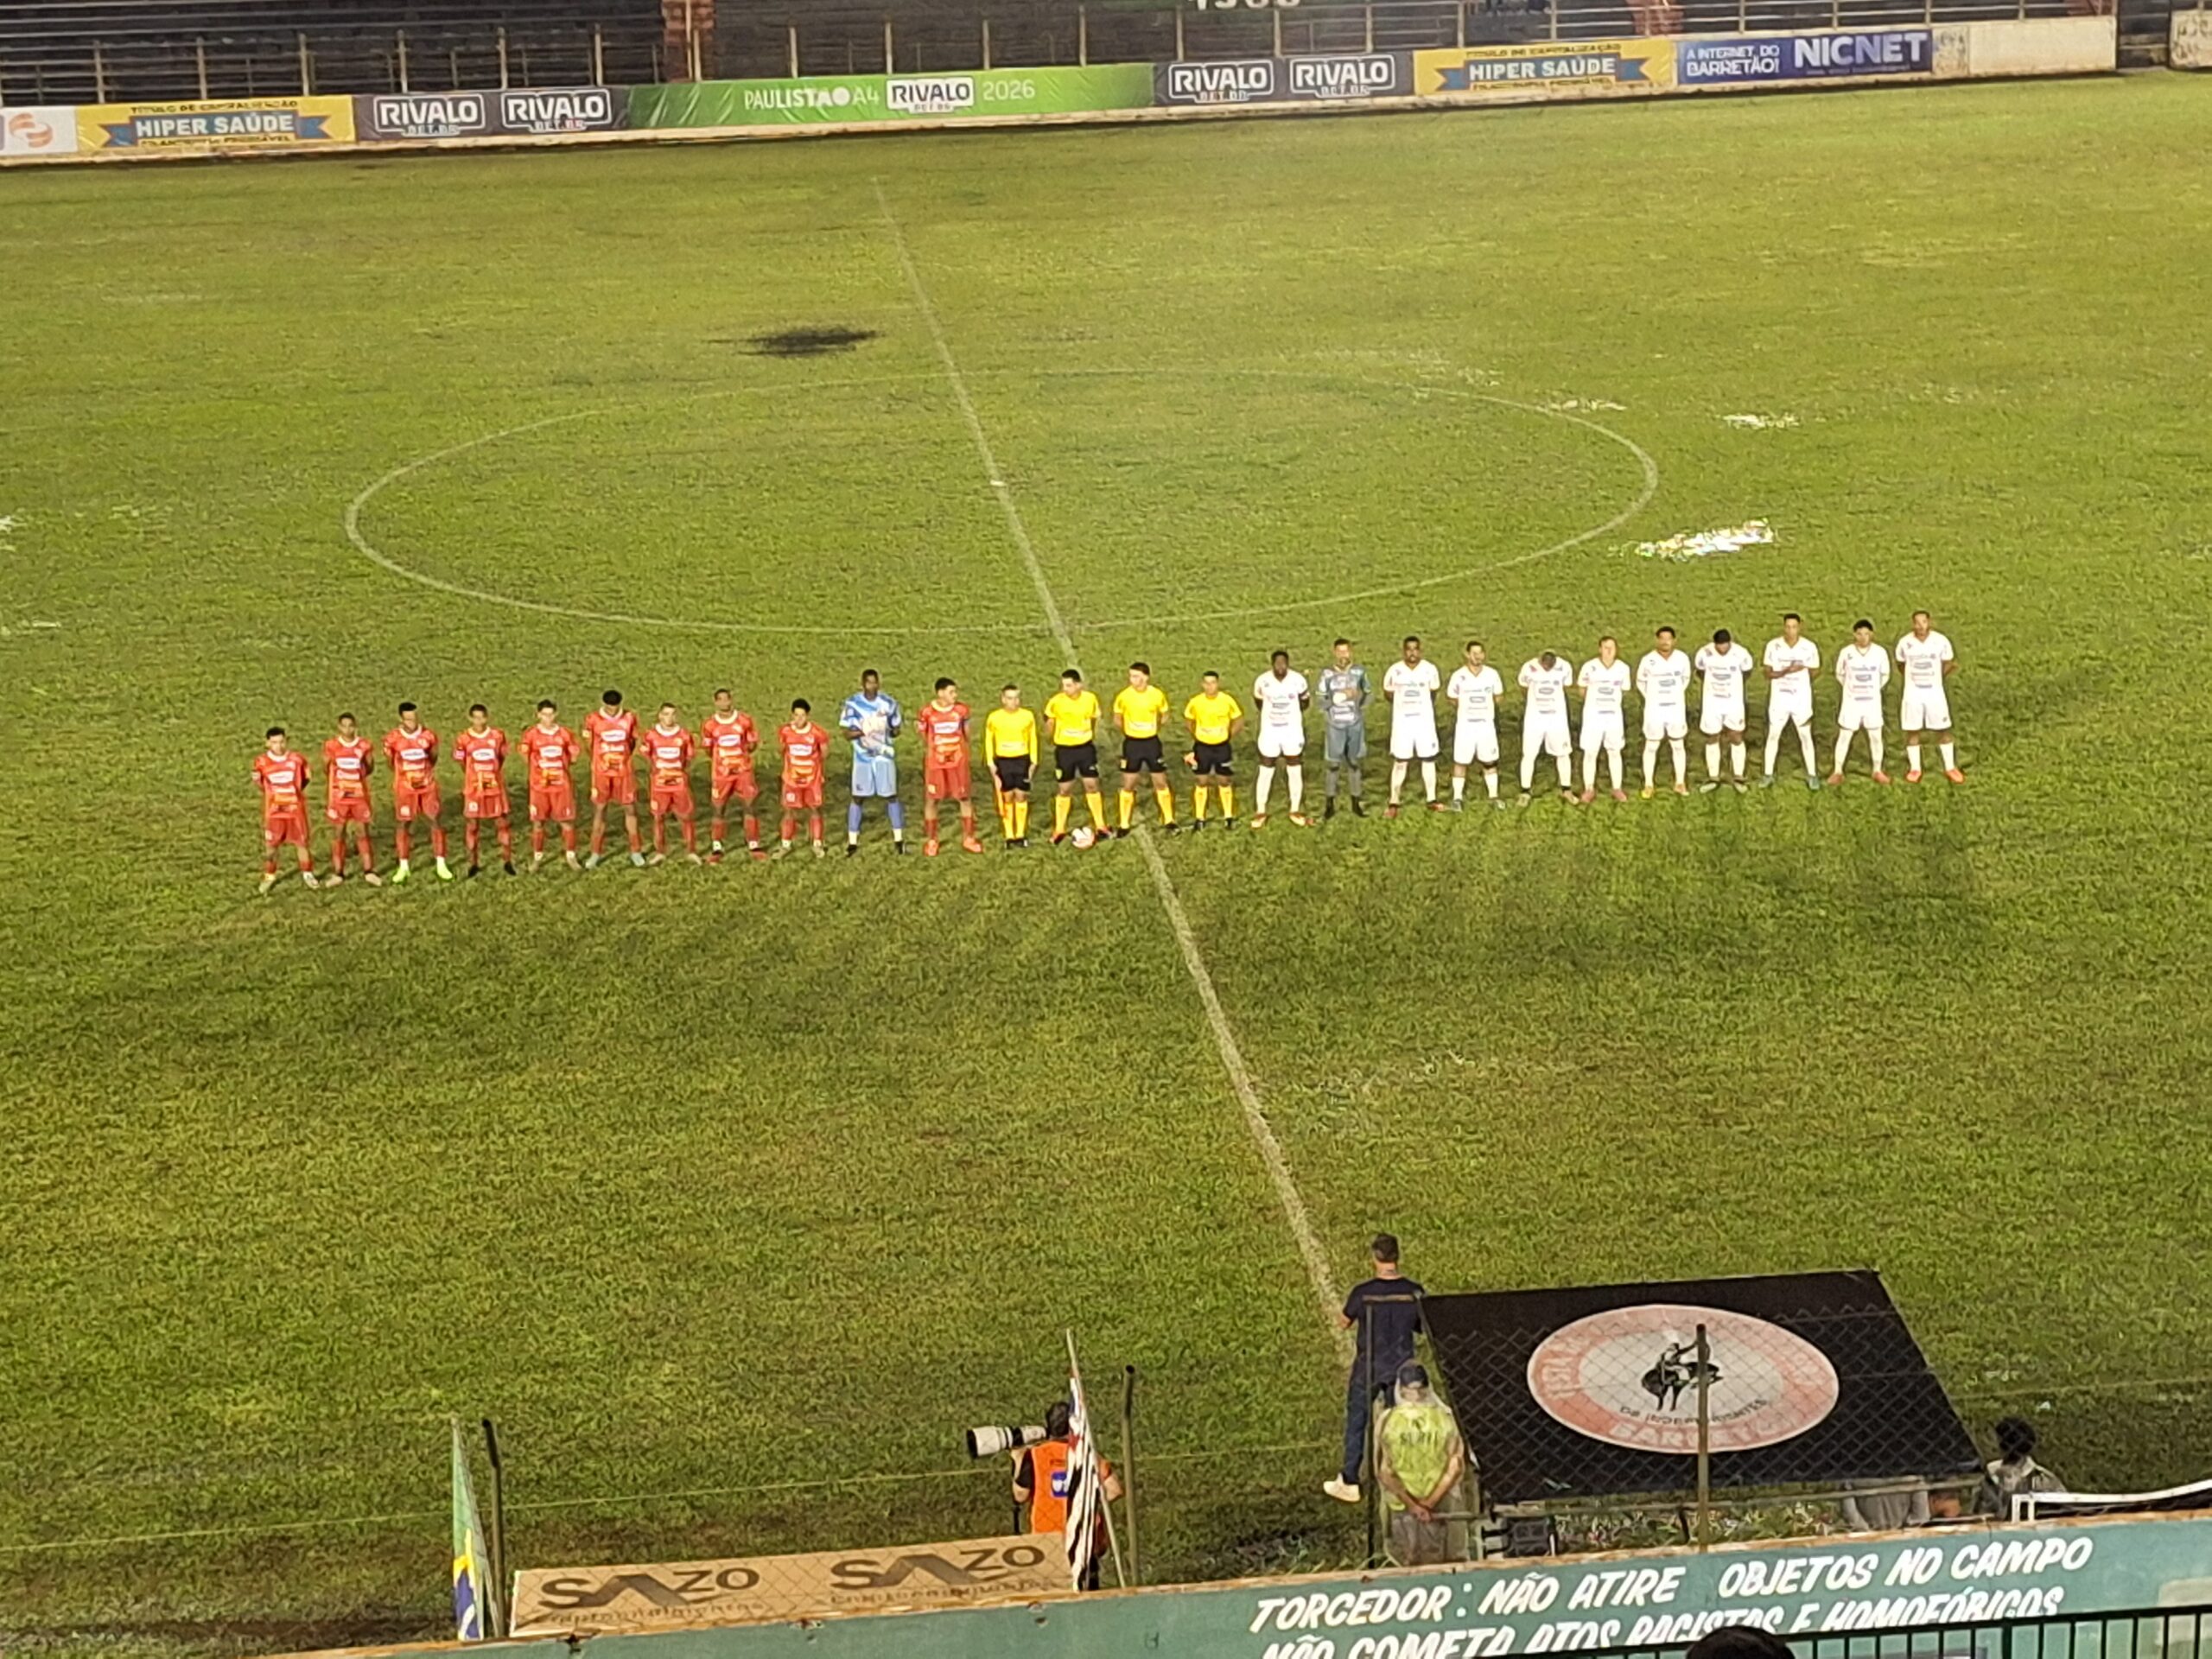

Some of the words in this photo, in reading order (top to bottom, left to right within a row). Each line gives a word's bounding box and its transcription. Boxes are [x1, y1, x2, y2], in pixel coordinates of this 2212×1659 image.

[1760, 45, 1780, 57] DO
[1795, 32, 1928, 68] NICNET
[1175, 67, 1268, 92] RIVALO
[1296, 61, 1389, 87] RIVALO
[1470, 61, 1536, 81] HIPER
[1541, 56, 1616, 77] SAÚDE
[892, 83, 970, 103] RIVALO
[983, 79, 1036, 101] 2026
[180, 103, 195, 111] DE
[380, 100, 478, 126] RIVALO
[507, 96, 605, 121] RIVALO
[136, 117, 208, 137] HIPER
[213, 112, 294, 134] SAÚDE
[830, 1545, 1046, 1590] SAZO
[1478, 1571, 1559, 1616] NÃO
[1567, 1566, 1687, 1611] ATIRE
[1718, 1554, 1878, 1599] OBJETOS
[1885, 1547, 1942, 1587] NO
[1950, 1536, 2094, 1580] CAMPO
[538, 1567, 760, 1609] SAZO
[1348, 1624, 1516, 1659] COMETA
[1523, 1619, 1622, 1655] ATOS
